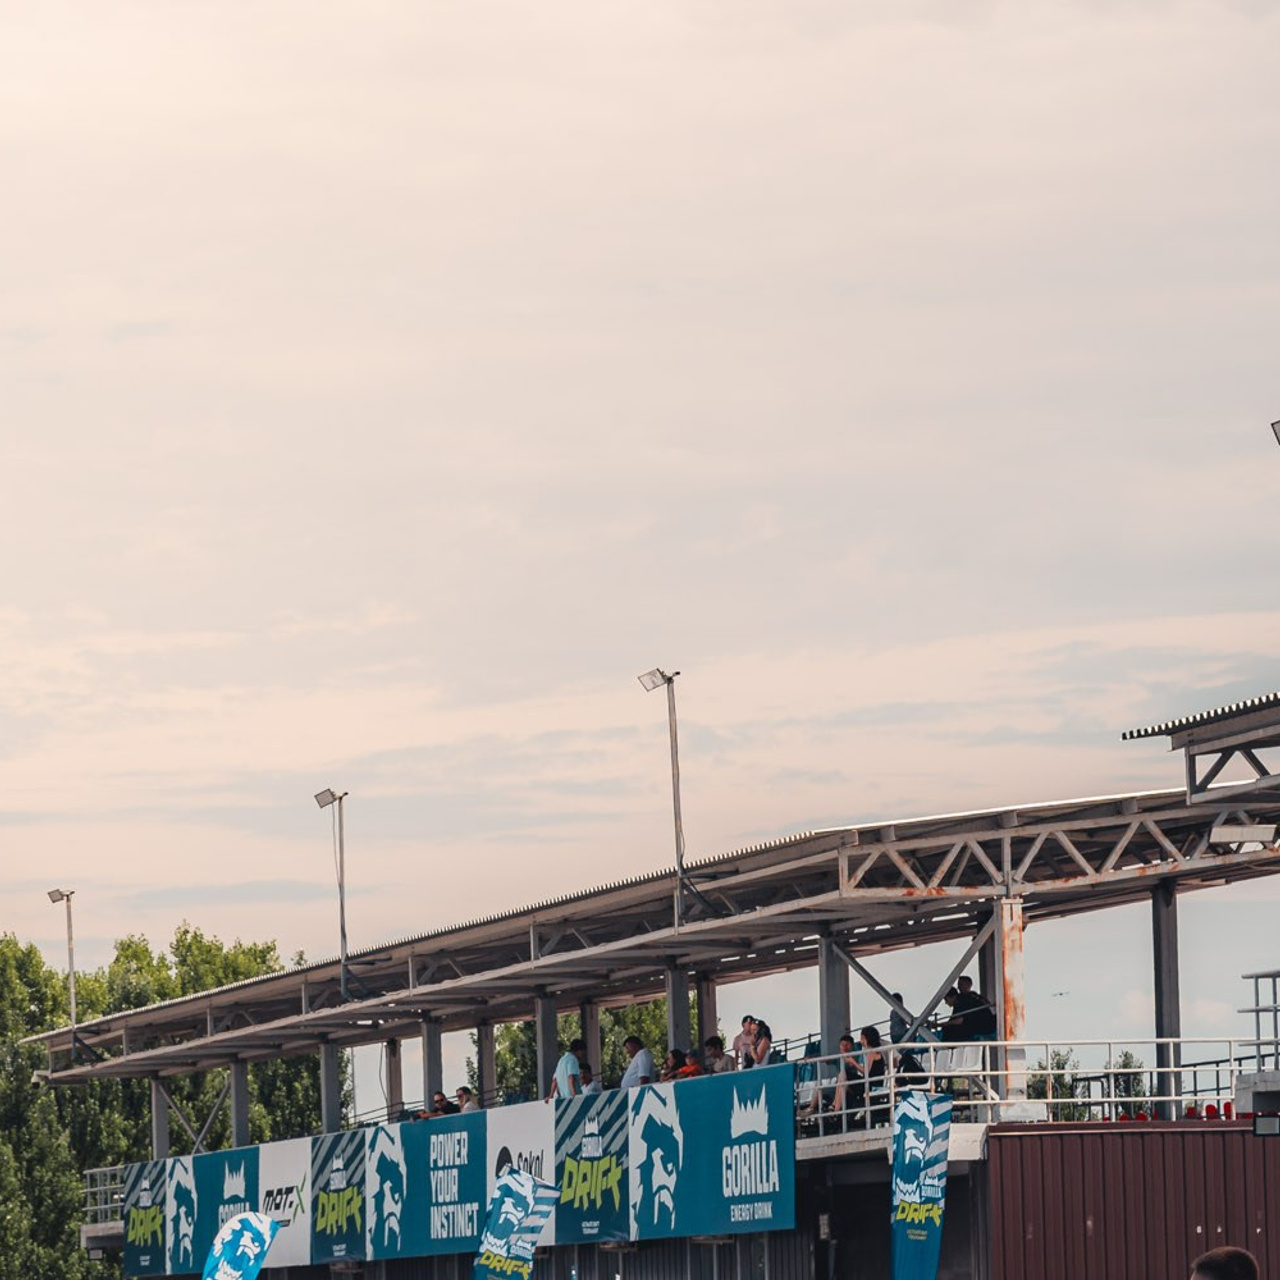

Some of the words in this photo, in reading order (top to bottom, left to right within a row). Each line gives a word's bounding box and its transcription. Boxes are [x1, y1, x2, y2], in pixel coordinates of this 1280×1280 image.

[430, 1131, 468, 1168] POWER
[430, 1168, 459, 1204] YOUR
[560, 1153, 622, 1212] DRIFT
[722, 1140, 780, 1197] GORILLA
[315, 1185, 362, 1236] DRIFT
[430, 1202, 479, 1239] INSTINCT
[730, 1203, 753, 1222] ENERGY
[754, 1201, 773, 1219] DRINK
[895, 1200, 943, 1227] DRIFT
